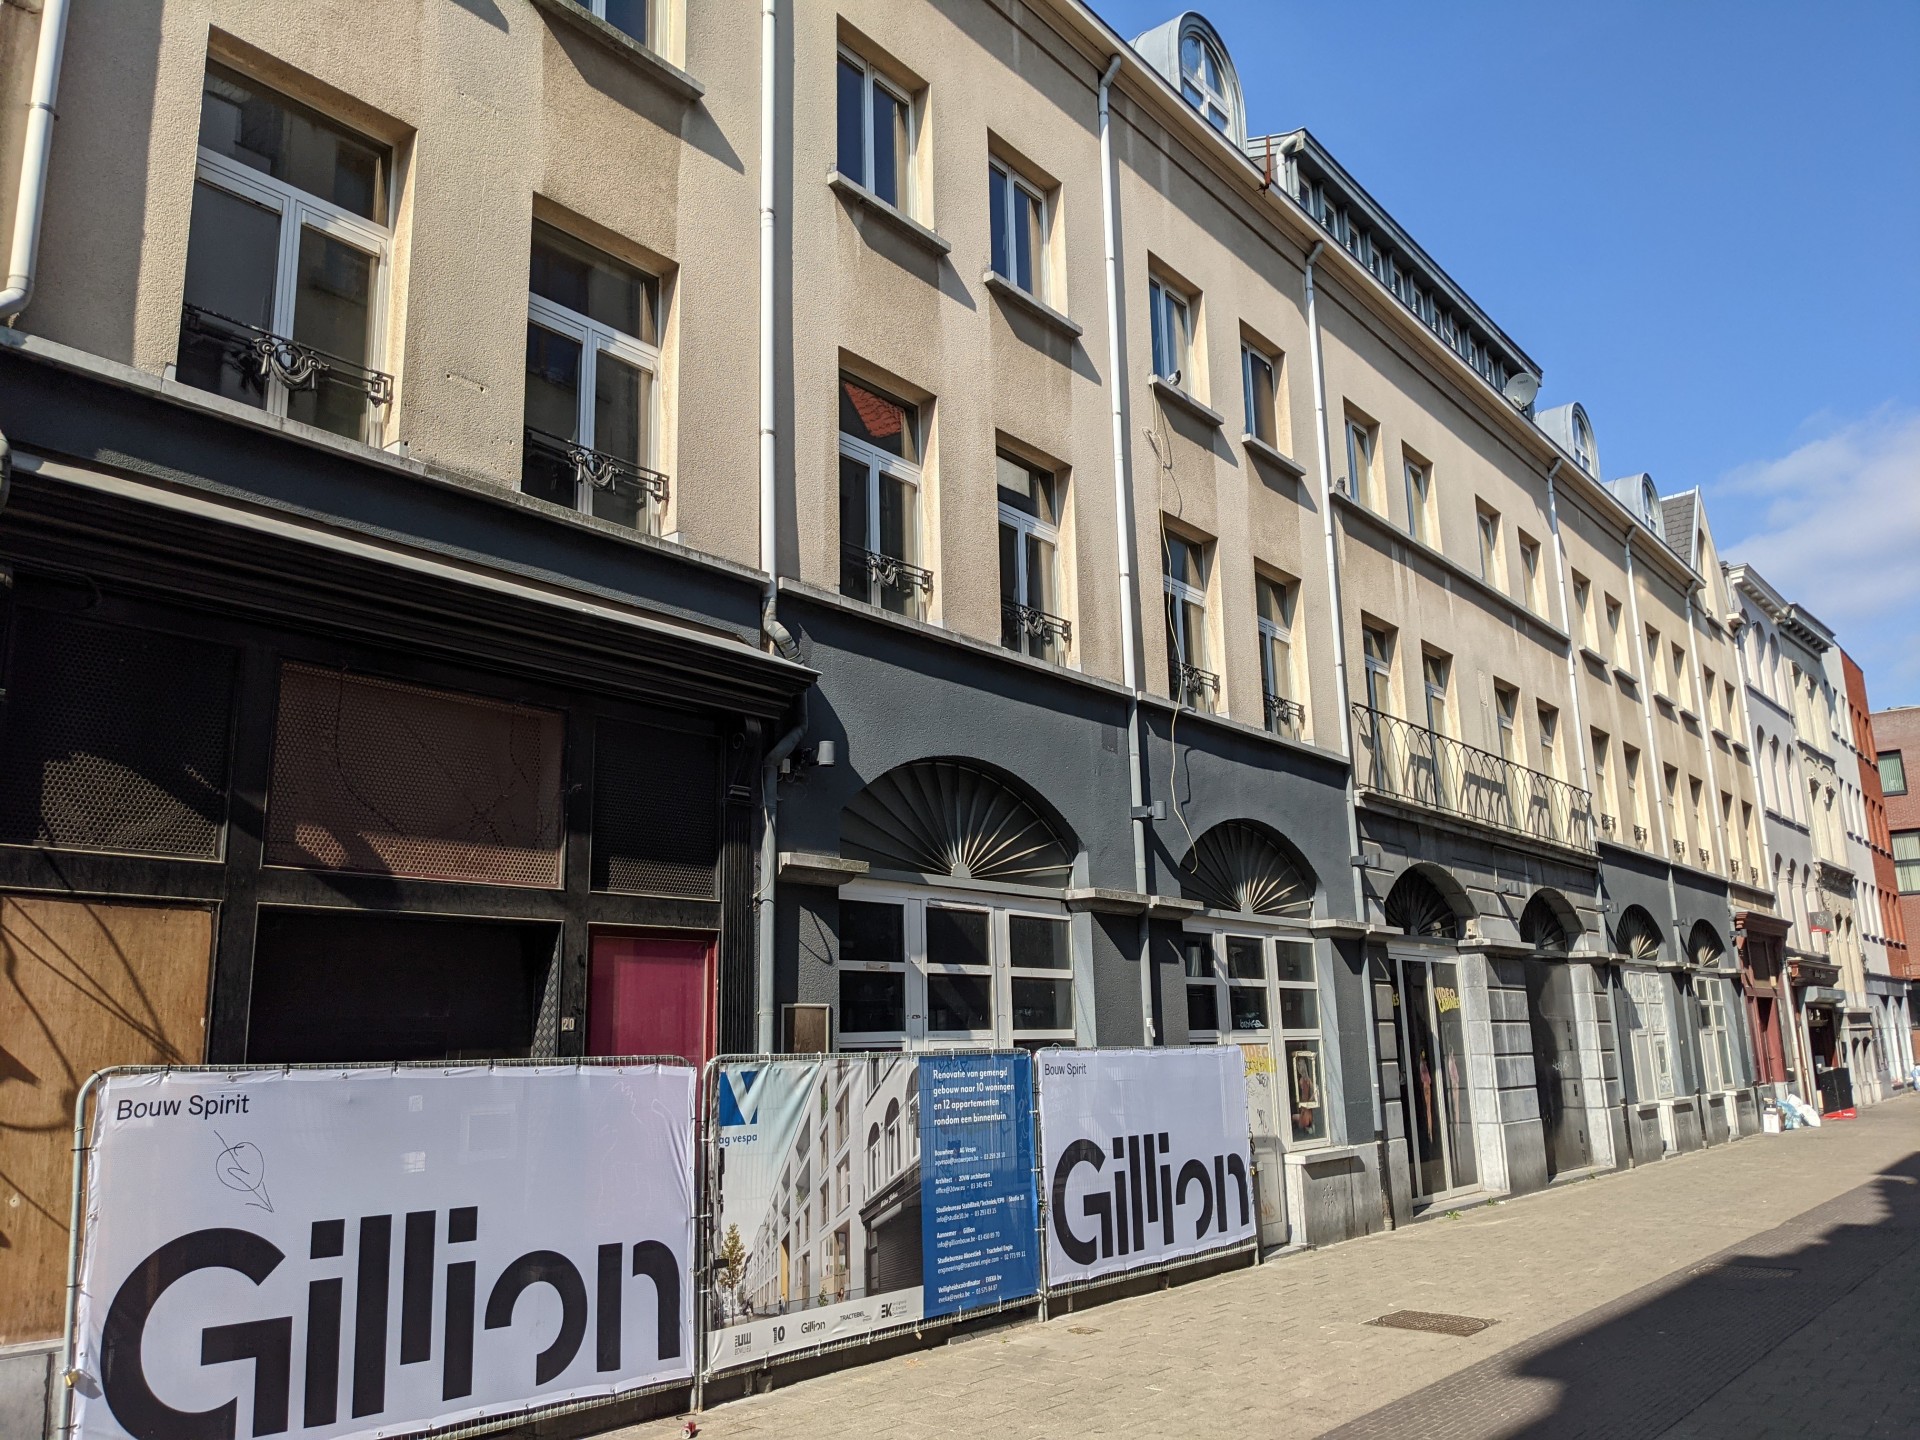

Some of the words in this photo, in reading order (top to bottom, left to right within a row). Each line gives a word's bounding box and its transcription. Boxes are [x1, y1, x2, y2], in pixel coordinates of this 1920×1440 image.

[563, 1018, 575, 1030] 20
[1243, 1045, 1268, 1059] IDEO
[933, 1069, 966, 1079] Renovatie
[979, 1067, 1008, 1079] gemengd
[1044, 1063, 1066, 1076] Bouw
[1067, 1063, 1087, 1078] Spirit
[933, 1085, 960, 1097] gebouw
[960, 1085, 975, 1093] naar
[976, 1083, 984, 1092] 10
[985, 1082, 1014, 1093] woningen
[116, 1095, 181, 1121] Bouw
[187, 1093, 250, 1121] Spirit
[943, 1100, 950, 1109] 12
[951, 1098, 1000, 1111] appartementen
[934, 1115, 960, 1126] rondom
[961, 1116, 972, 1124] een
[973, 1111, 1006, 1122] binnentuin
[719, 1136, 730, 1147] ag
[732, 1133, 758, 1145] vespa
[1052, 1132, 1250, 1266] Gillion
[100, 1206, 681, 1440] Gillion
[801, 1320, 826, 1334] Gillion
